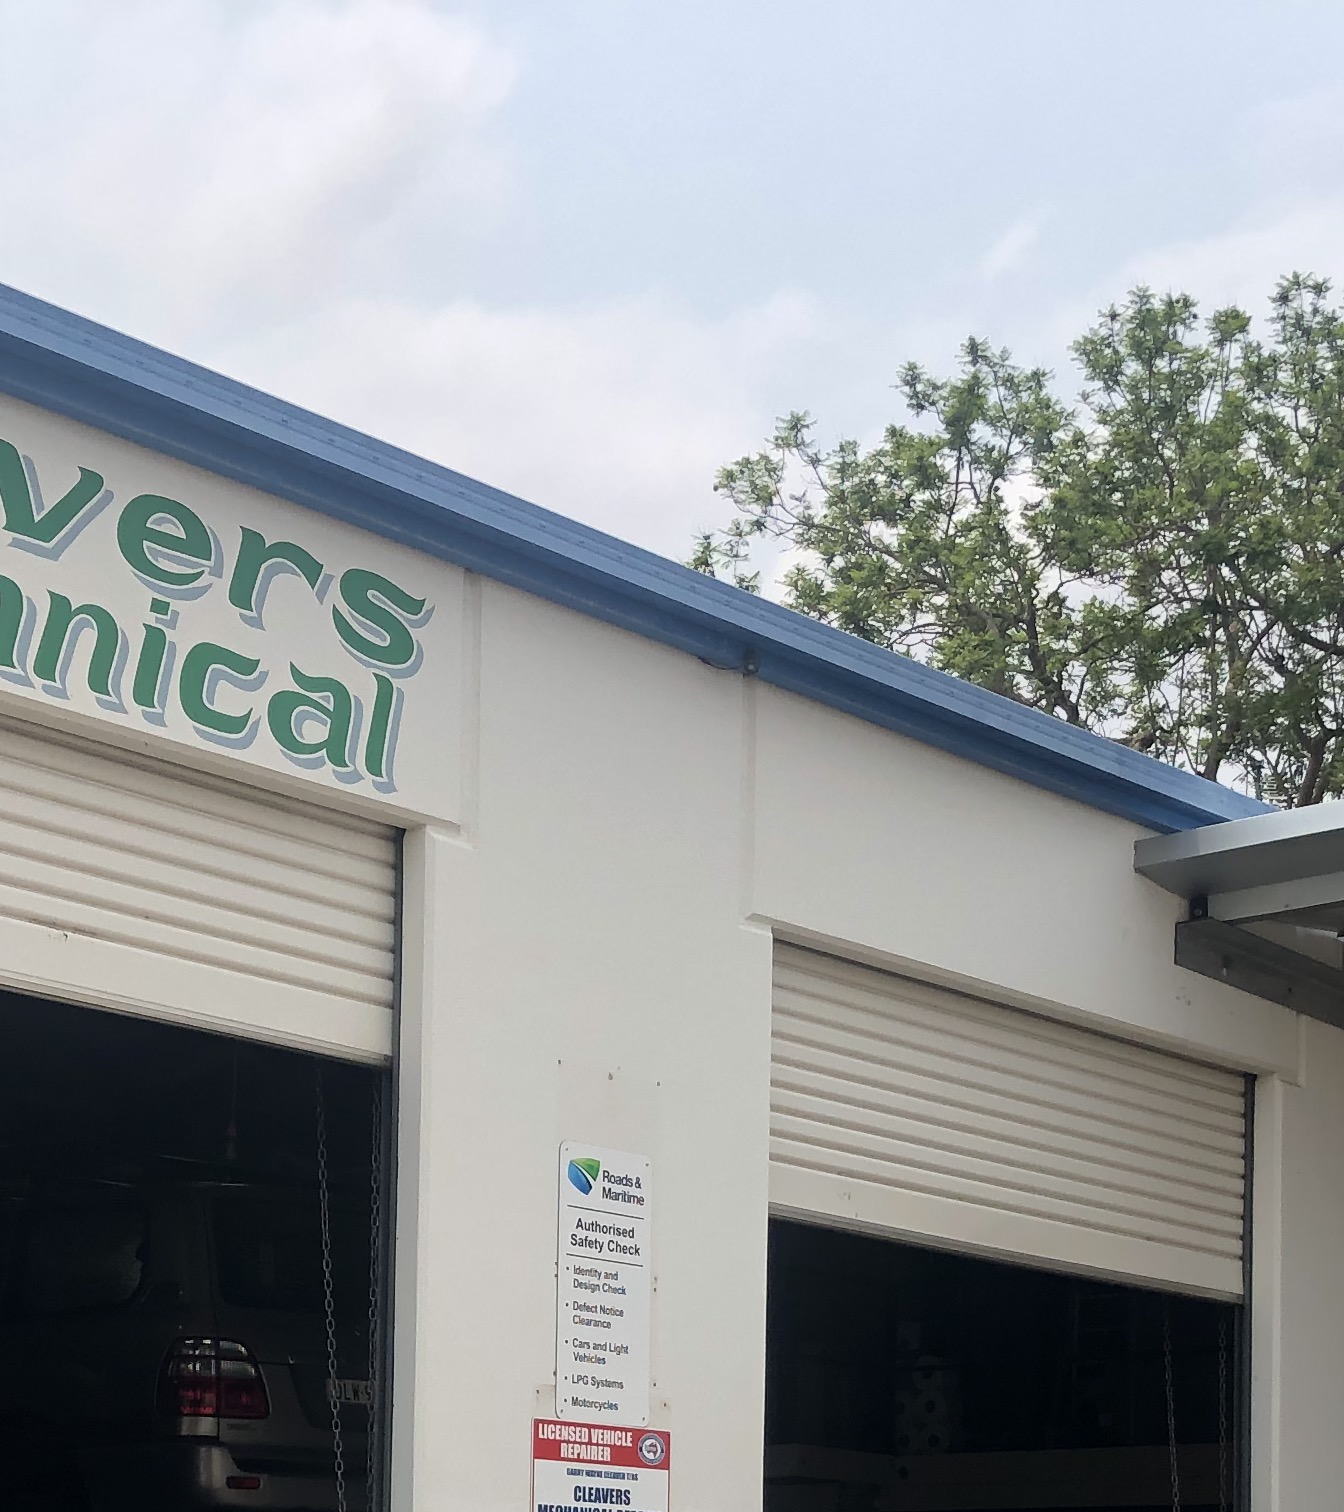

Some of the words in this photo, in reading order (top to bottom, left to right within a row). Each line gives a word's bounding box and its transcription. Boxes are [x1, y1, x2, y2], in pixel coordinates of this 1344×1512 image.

[602, 1170, 633, 1188] Roads
[634, 1177, 642, 1190] &
[602, 1187, 645, 1206] Maritime
[575, 1218, 635, 1239] Authorised
[570, 1234, 604, 1253] Safety
[607, 1240, 641, 1257] Check
[573, 1265, 602, 1281] Identity
[604, 1270, 619, 1281] and
[573, 1278, 600, 1294] Design
[602, 1282, 627, 1296] Check
[572, 1301, 598, 1314] Defect
[599, 1305, 624, 1318] Notice
[572, 1315, 611, 1330] Clearance
[572, 1338, 591, 1350] Cars
[592, 1341, 607, 1352] and
[608, 1342, 629, 1357] Light
[573, 1352, 606, 1365] Vehicles
[571, 1374, 589, 1386] LPG
[590, 1376, 624, 1390] Systems
[571, 1397, 619, 1412] Motorcycles
[538, 1423, 589, 1443] LICENSED
[590, 1428, 633, 1447] VEHICLE
[560, 1443, 611, 1461] REPAIRER
[573, 1485, 631, 1506] CLEAVERS
